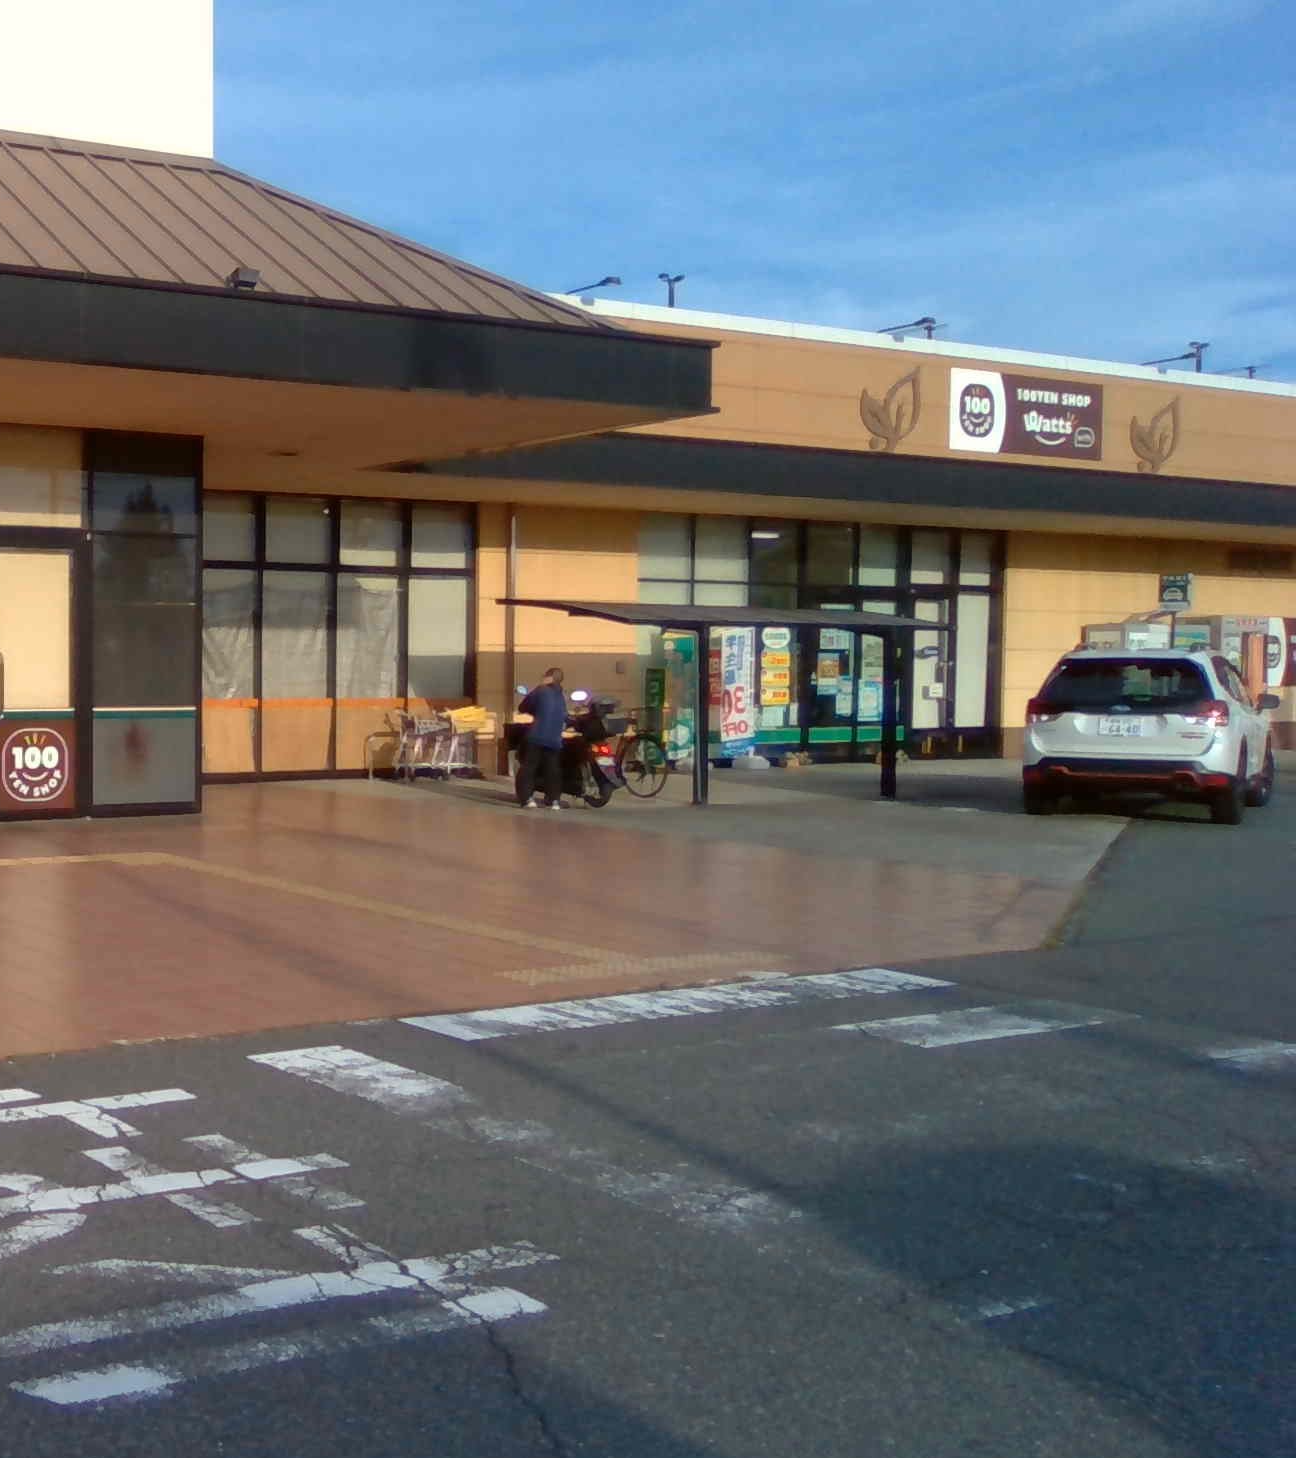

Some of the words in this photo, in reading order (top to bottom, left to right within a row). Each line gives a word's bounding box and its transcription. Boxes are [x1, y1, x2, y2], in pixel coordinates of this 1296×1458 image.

[964, 395, 991, 415] 100
[1061, 392, 1092, 408] SHOP
[1023, 410, 1073, 435] Watts
[11, 746, 60, 770] 100
[8, 770, 30, 796] YEN
[32, 769, 62, 797] SHOP
